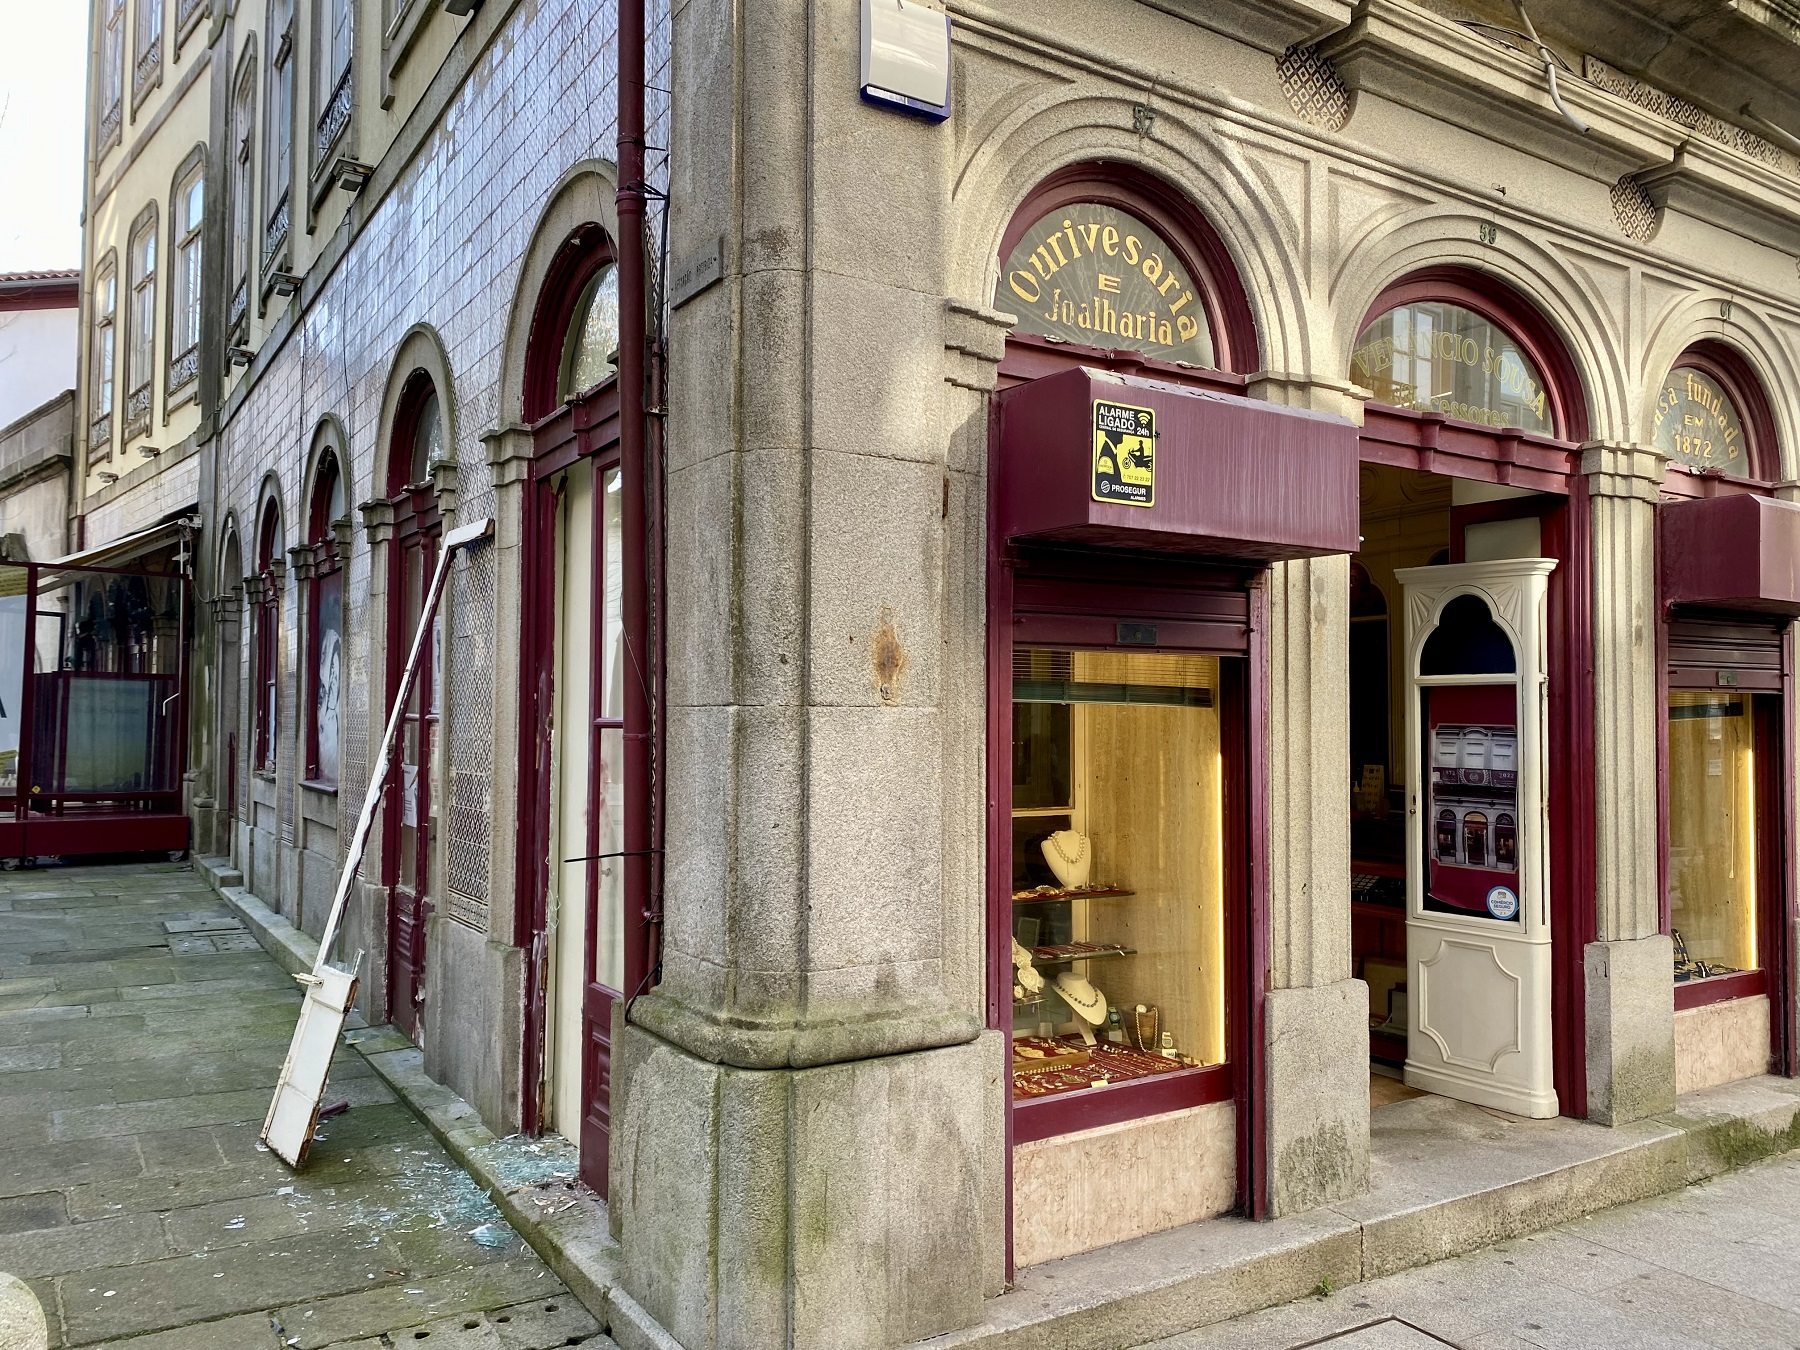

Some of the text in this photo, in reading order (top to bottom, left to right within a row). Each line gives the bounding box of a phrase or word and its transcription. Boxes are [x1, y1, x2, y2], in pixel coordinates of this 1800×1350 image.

[1479, 222, 1497, 245] 59
[1009, 219, 1198, 344] Ourivesaria
[1098, 273, 1121, 294] E
[1044, 287, 1174, 346] Joalharia
[1352, 320, 1546, 421] VENÂNCIO SOUSA
[1098, 414, 1135, 430] LIGADO
[1099, 405, 1135, 420] ALARME
[1684, 414, 1704, 427] EM
[1686, 373, 1739, 460] fundada
[1136, 426, 1150, 436] 24h
[1674, 434, 1712, 458] 1872
[1111, 484, 1147, 496] PROSEGUR
